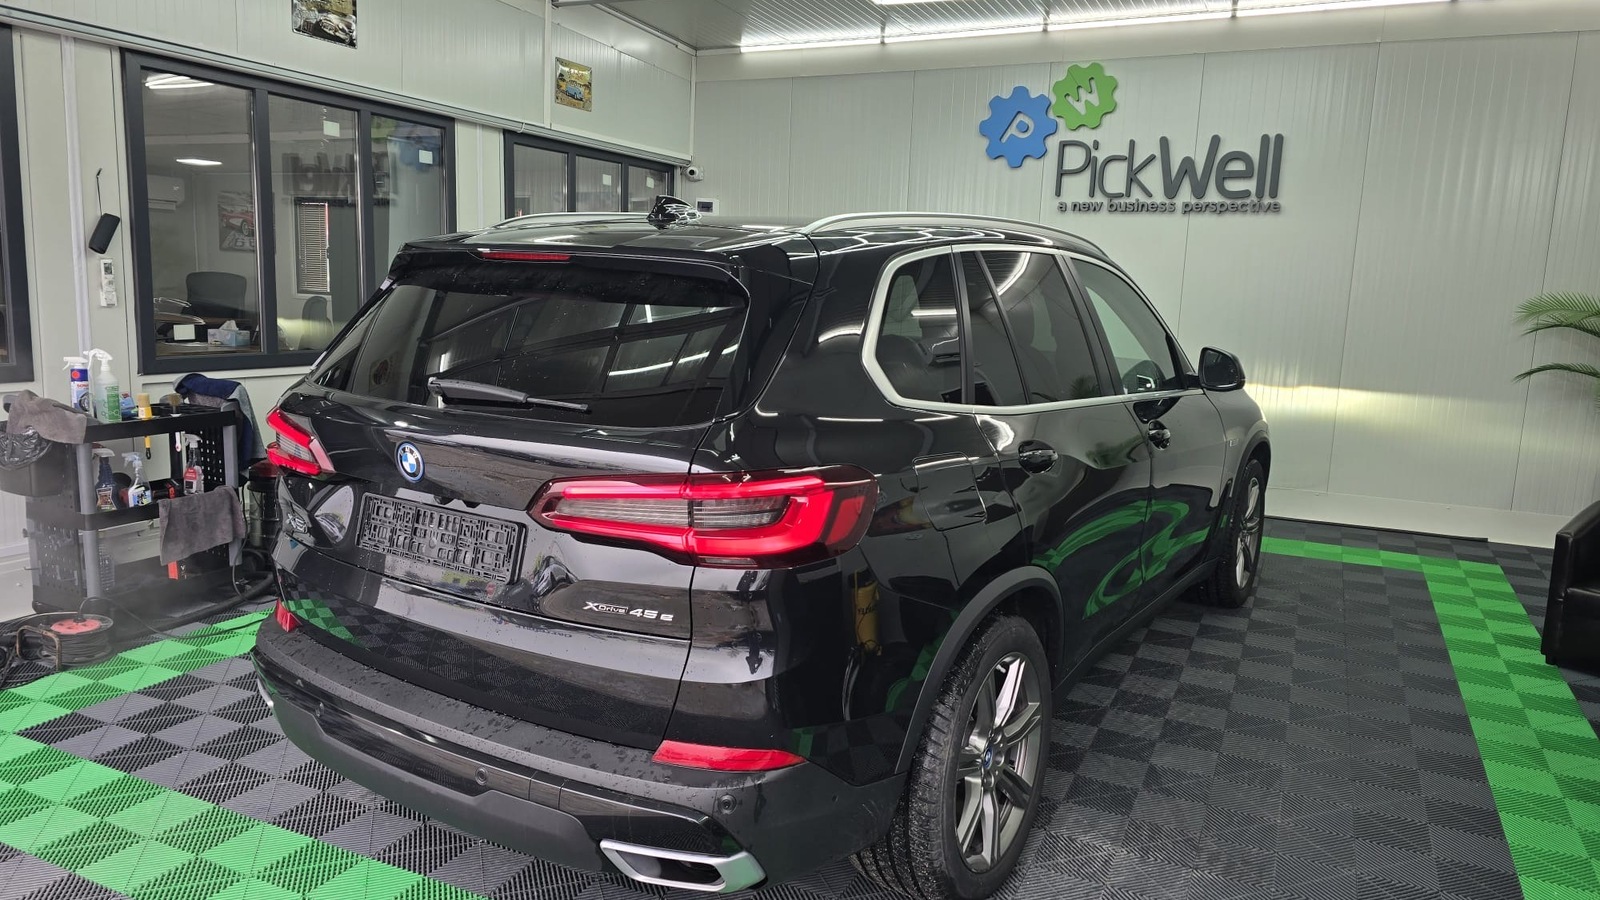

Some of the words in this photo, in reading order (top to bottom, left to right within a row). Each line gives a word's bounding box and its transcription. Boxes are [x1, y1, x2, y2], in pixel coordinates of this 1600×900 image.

[1055, 133, 1284, 199] PickWell
[1057, 201, 1067, 212] a
[1071, 201, 1103, 212] new
[1107, 198, 1176, 212] business
[1182, 198, 1281, 214] perspective
